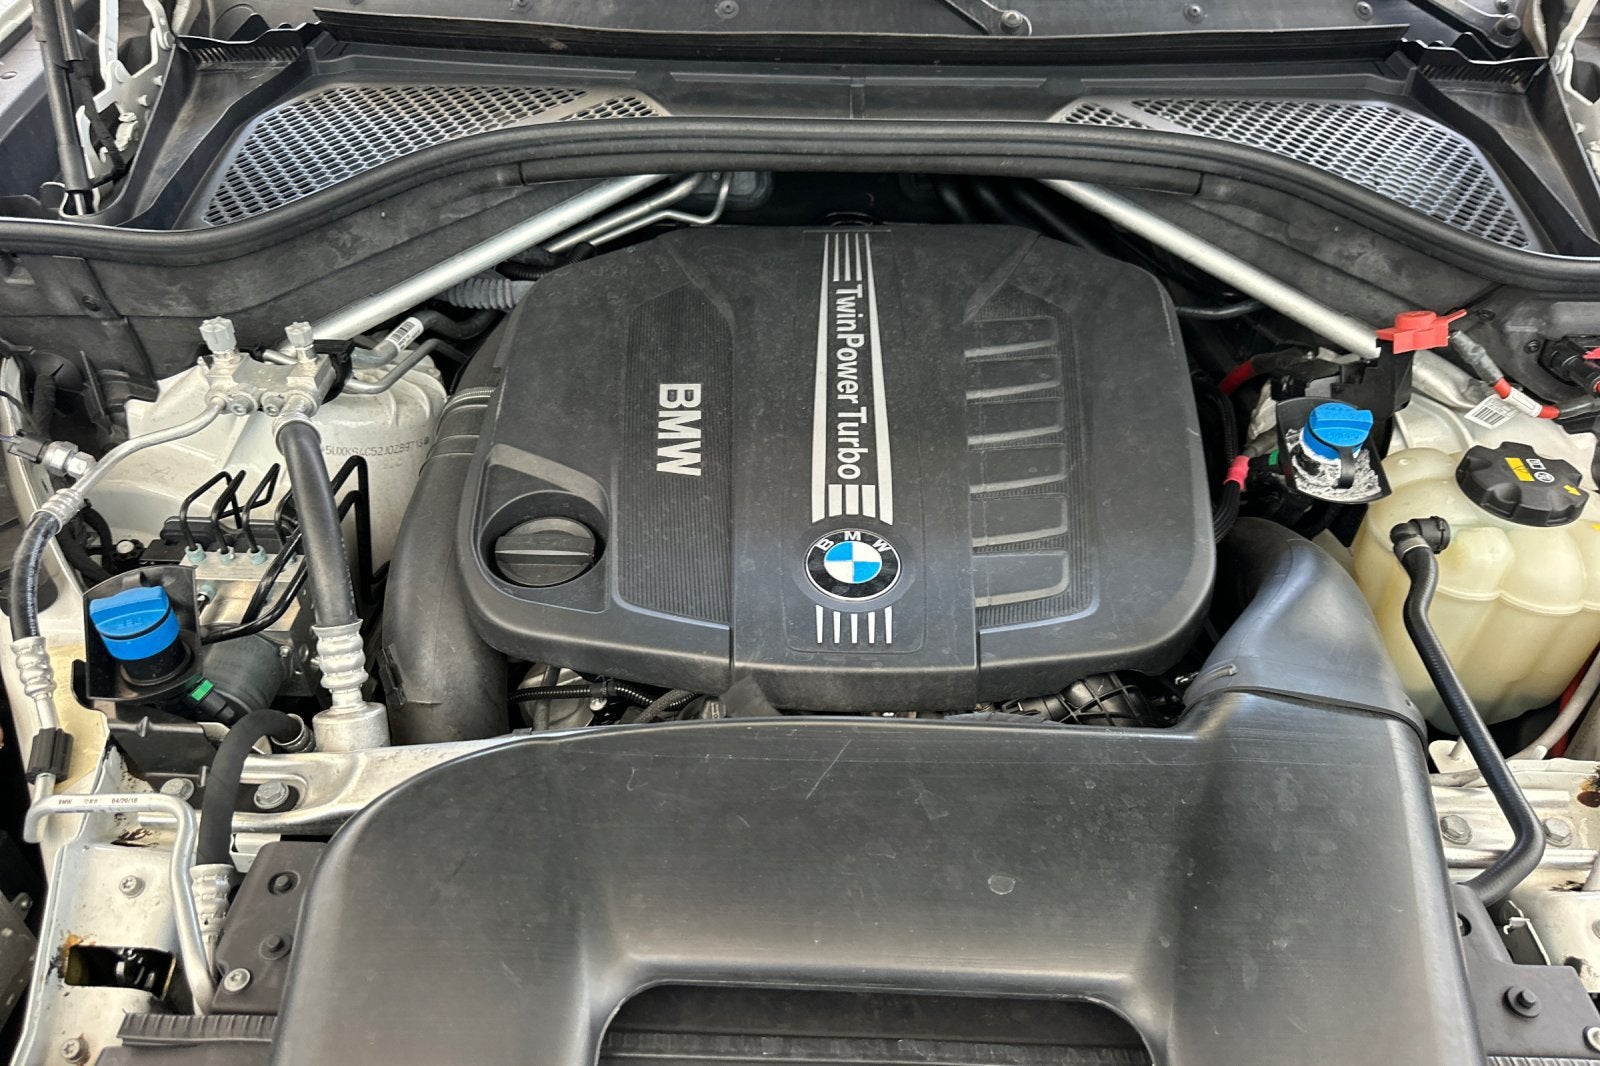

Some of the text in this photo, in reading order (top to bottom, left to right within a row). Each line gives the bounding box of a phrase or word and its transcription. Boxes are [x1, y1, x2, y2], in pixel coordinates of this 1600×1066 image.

[656, 383, 702, 476] BMW
[837, 406, 869, 480] Turbo
[815, 530, 892, 553] BMW
